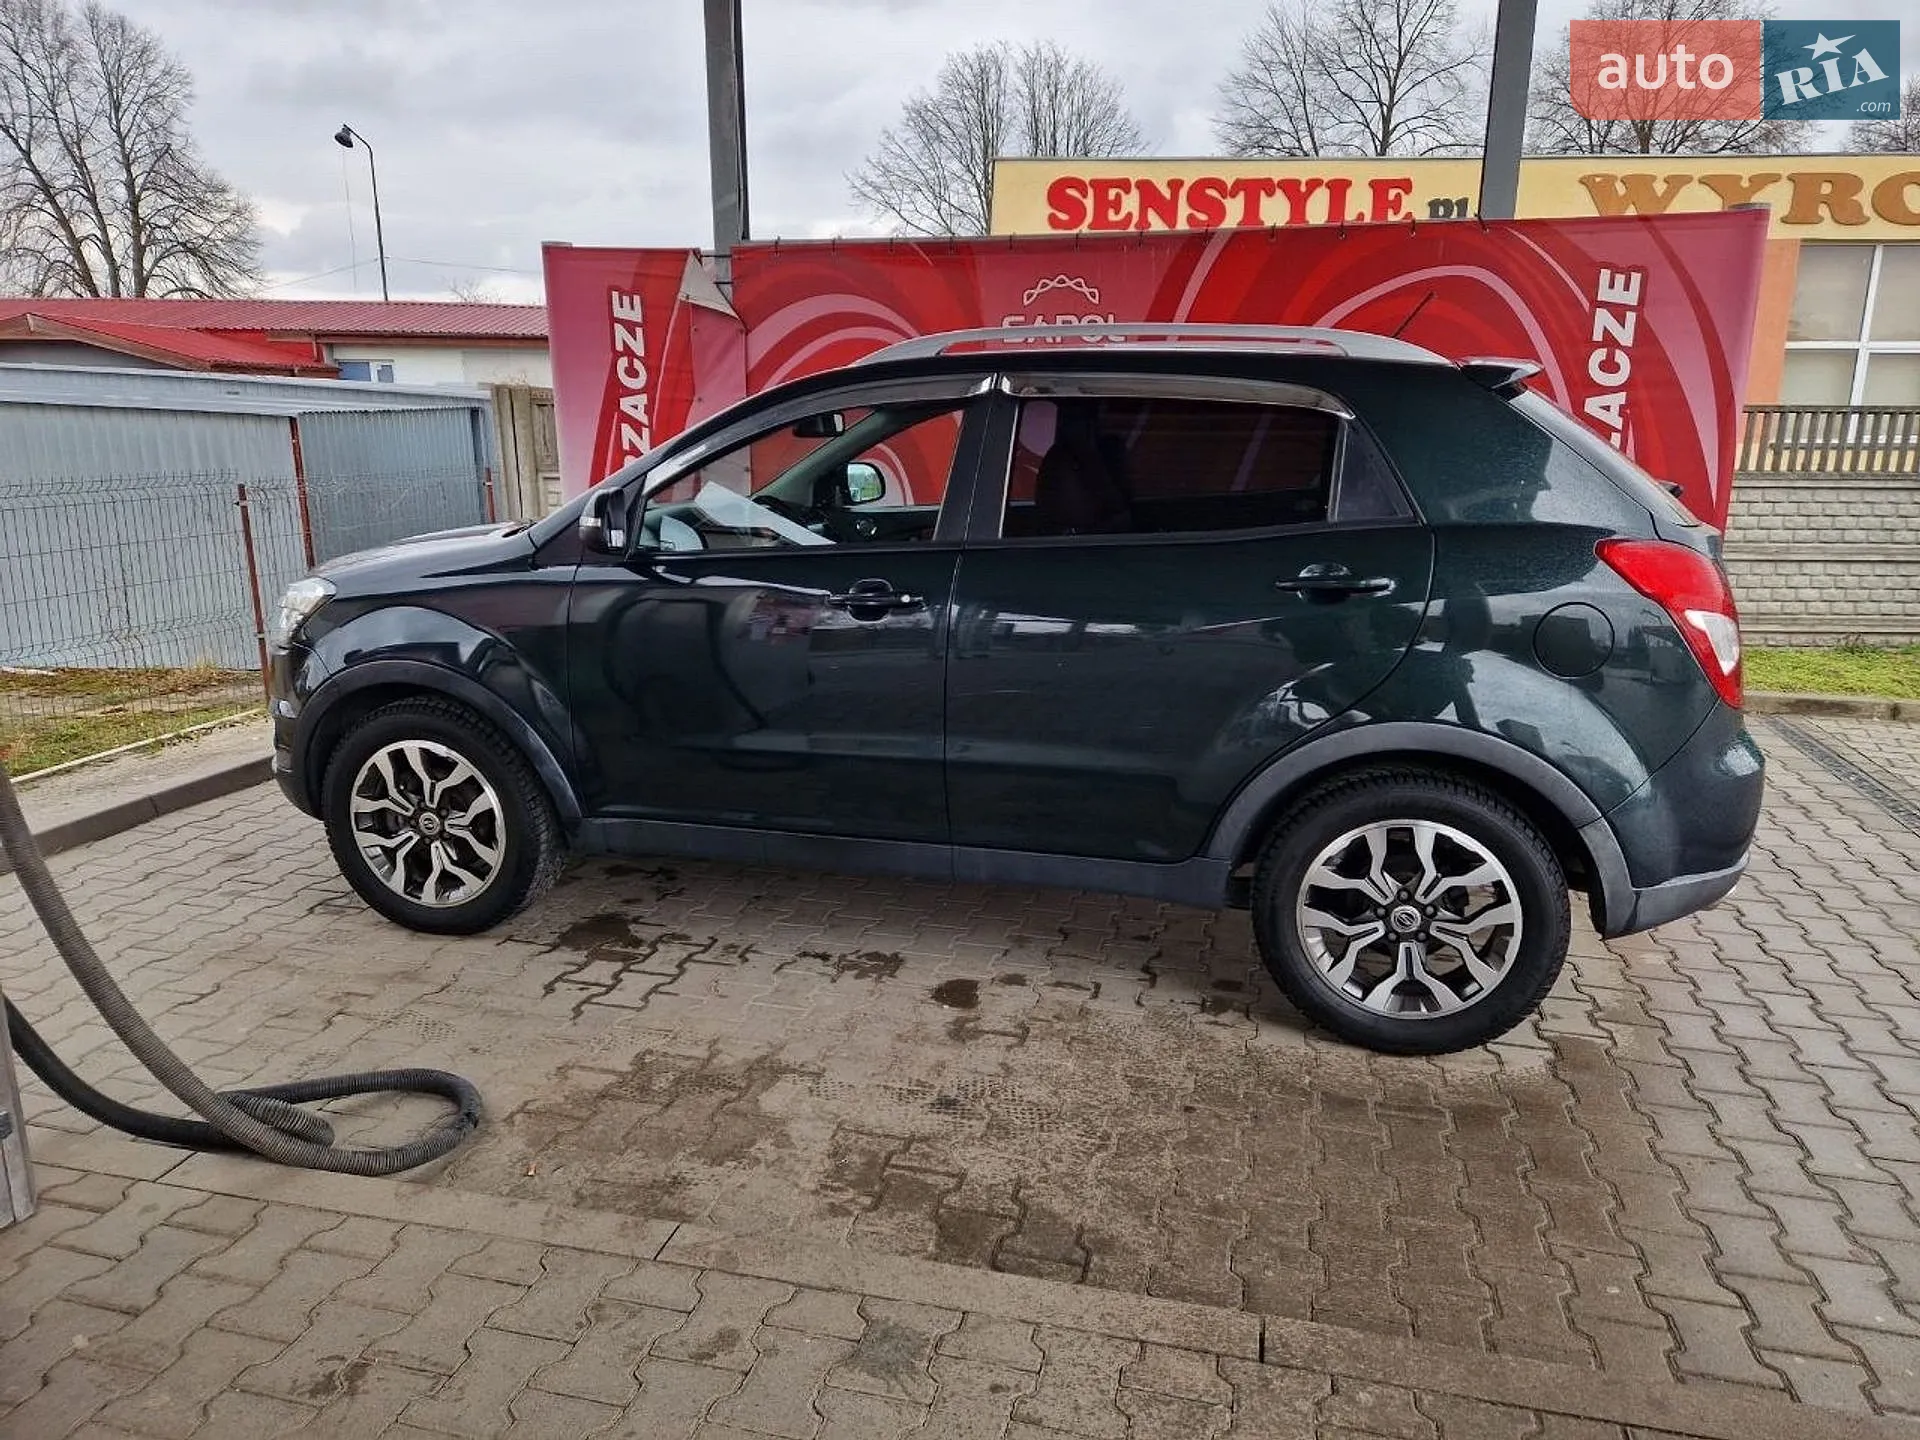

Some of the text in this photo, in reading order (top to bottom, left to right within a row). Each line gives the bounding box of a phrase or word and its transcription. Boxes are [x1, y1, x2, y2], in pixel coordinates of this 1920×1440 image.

[1047, 176, 1413, 231] SENSTYLE
[612, 291, 651, 470] ZACZE
[1584, 268, 1642, 449] ACZE
